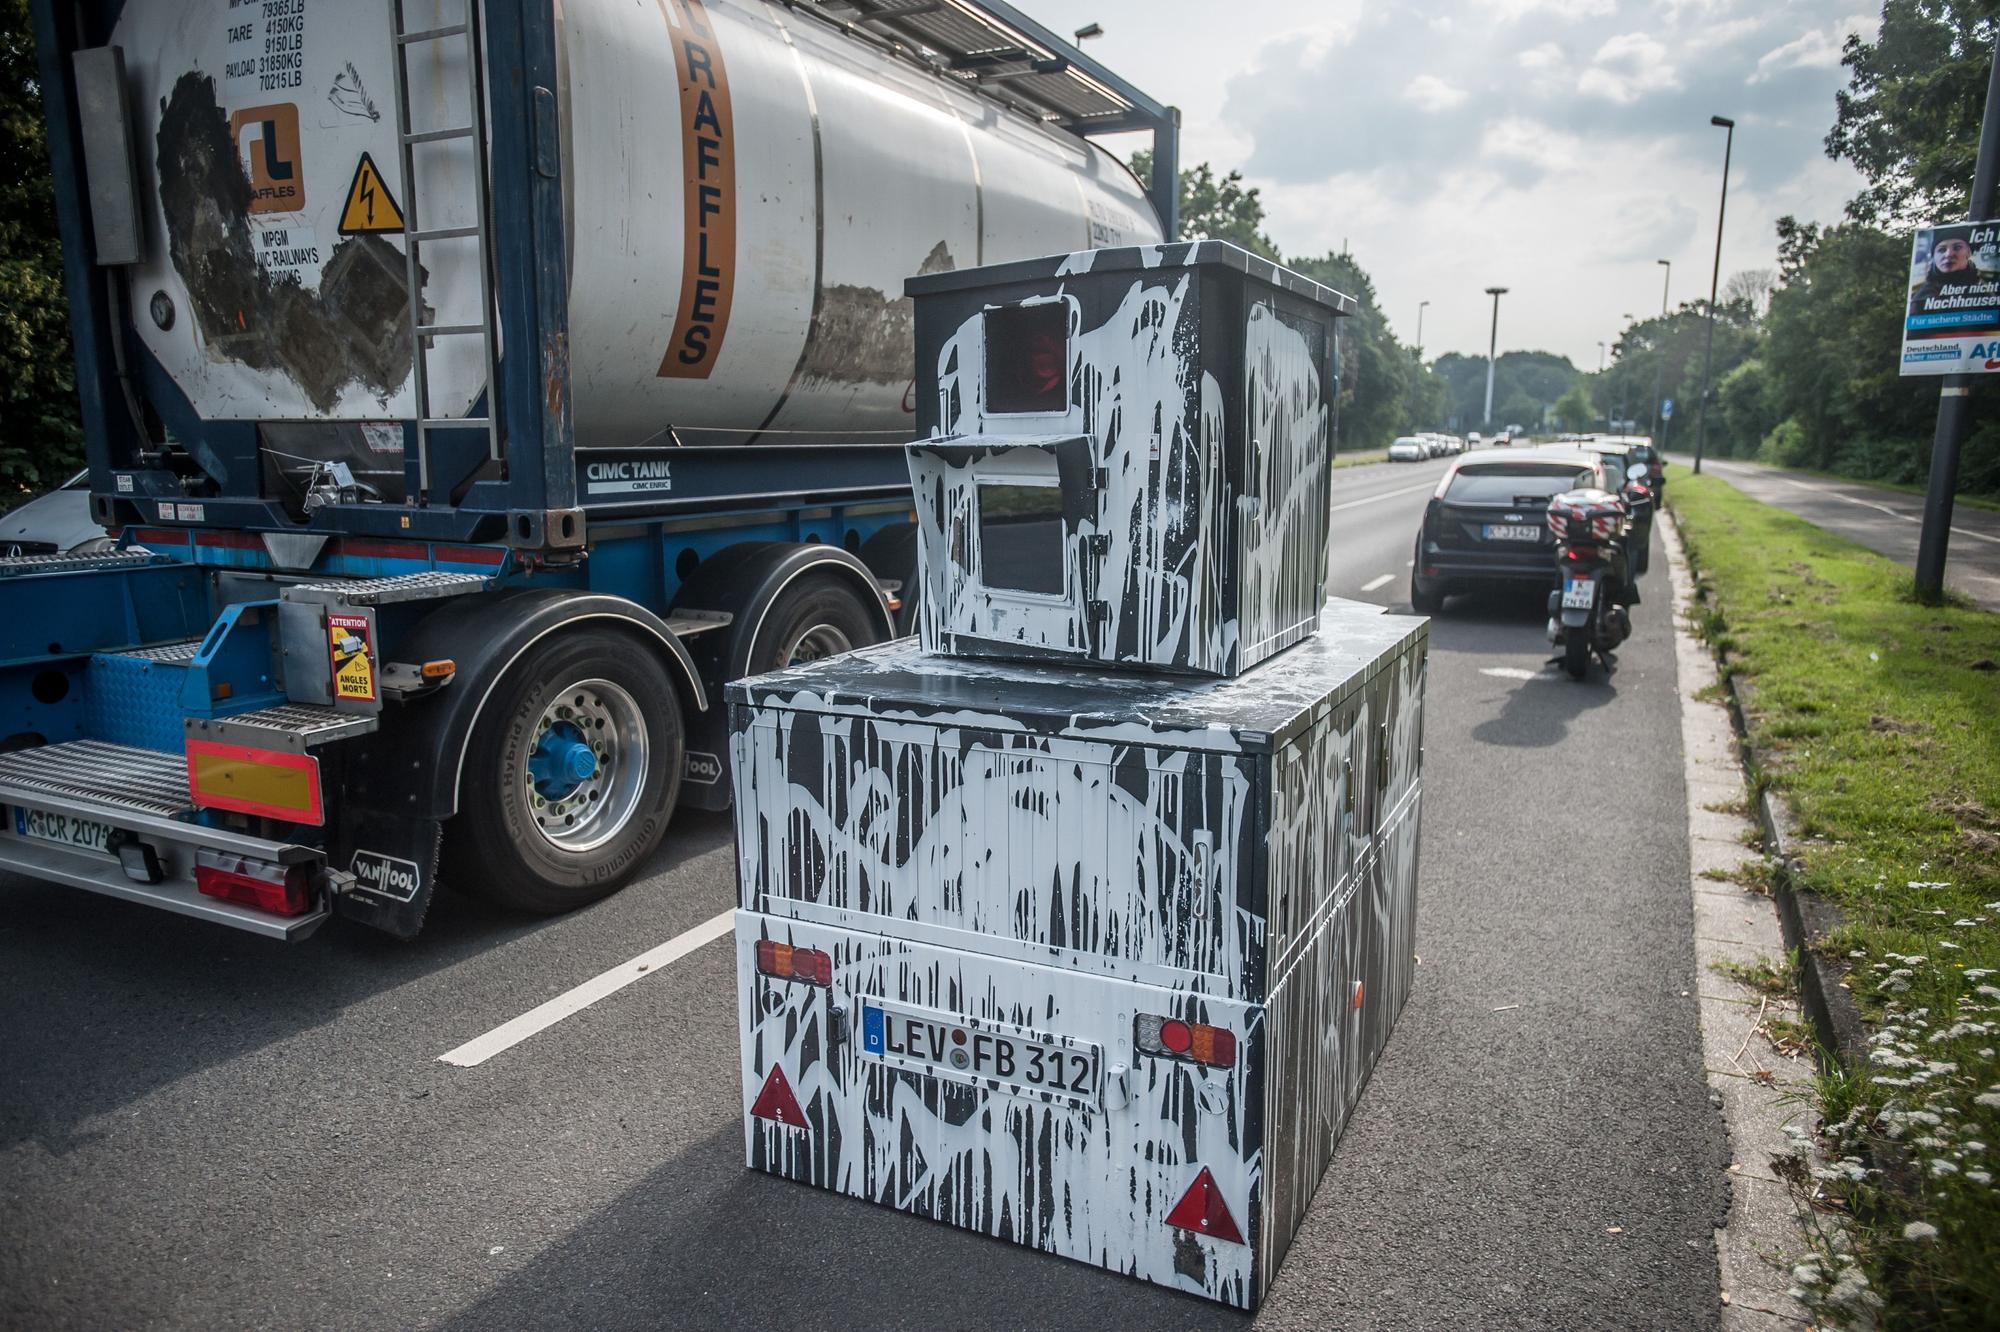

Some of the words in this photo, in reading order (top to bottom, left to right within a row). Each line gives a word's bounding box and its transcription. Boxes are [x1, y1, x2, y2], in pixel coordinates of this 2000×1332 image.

[262, 1, 290, 19] 79365
[228, 24, 253, 43] TARE
[265, 16, 304, 36] 4150KG
[265, 36, 287, 54] 9150
[226, 59, 256, 79] PAYLOAD
[259, 52, 302, 72] 31850KG
[260, 73, 287, 91] 70215
[252, 185, 296, 201] AFFLES
[679, 39, 723, 366] RAFFLES
[262, 229, 289, 248] MPGM
[1969, 227, 1994, 243] Ich
[272, 247, 319, 267] RAILWAYS
[1980, 243, 1997, 255] die
[1939, 284, 1968, 296] Aber
[1968, 281, 1999, 294] nicht
[587, 463, 629, 480] CIMC
[631, 461, 671, 478] TANK
[632, 482, 649, 490] CIMC
[649, 481, 668, 489] ENRIC
[331, 618, 367, 627] ATTENTION
[340, 674, 368, 685] ANGLES
[342, 684, 368, 694] MORTS
[503, 722, 523, 787] Hybrid
[25, 808, 37, 834] K
[46, 812, 69, 841] CR
[503, 792, 522, 840] Conti
[886, 1015, 946, 1062] LEV
[973, 1034, 1016, 1078] FB
[1025, 1044, 1090, 1095] 312
